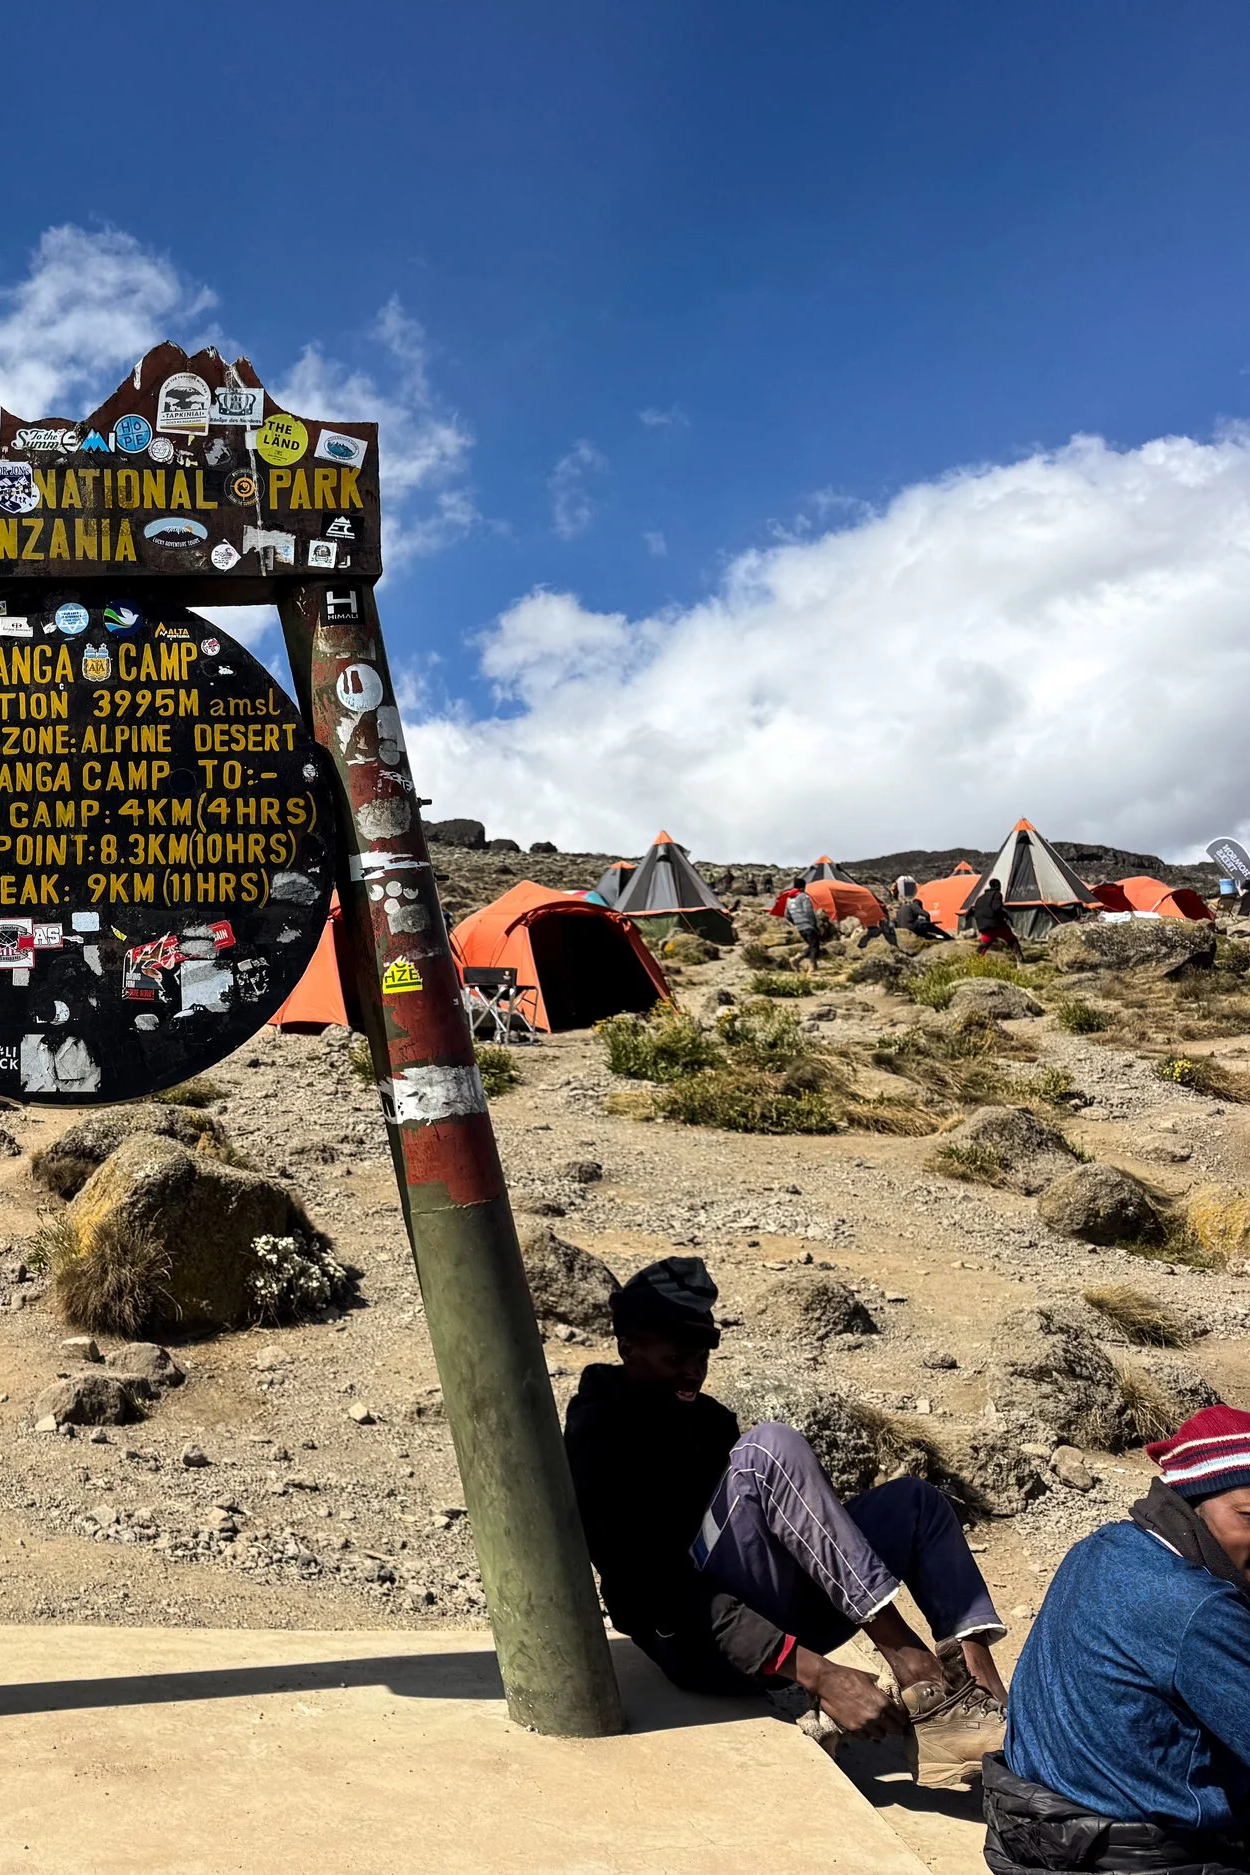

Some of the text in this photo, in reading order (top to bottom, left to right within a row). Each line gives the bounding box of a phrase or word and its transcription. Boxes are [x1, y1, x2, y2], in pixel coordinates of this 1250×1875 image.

[30, 430, 57, 440] To the
[268, 421, 292, 435] THE
[263, 434, 300, 451] LÄND
[34, 468, 219, 511] NATIONAL
[269, 467, 364, 510] PARK
[152, 537, 165, 546] LUCKY
[187, 537, 201, 546] TOURS
[327, 613, 359, 621] HIMALI
[119, 642, 198, 682] CAMP
[92, 688, 199, 718] 3995M
[209, 688, 281, 717] amsl
[194, 724, 297, 753] DESERT
[82, 760, 171, 793] CAMP
